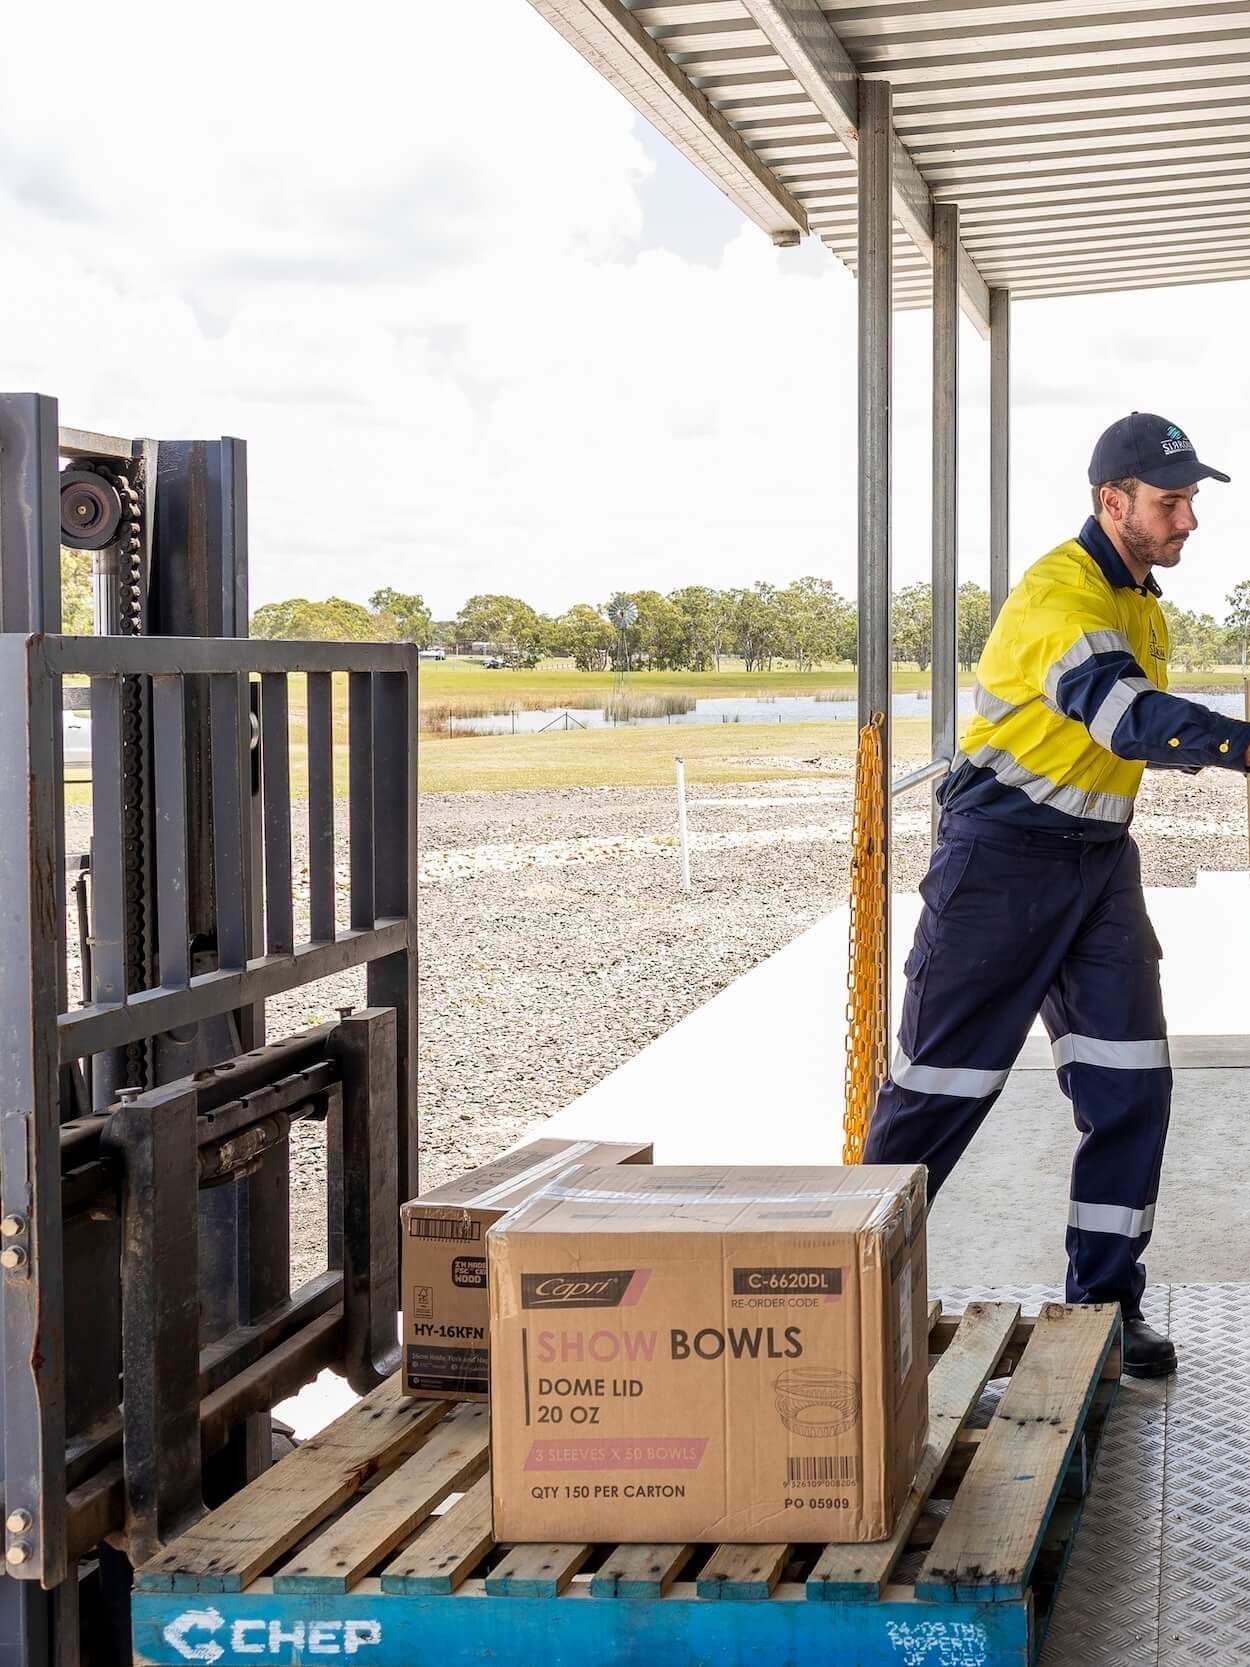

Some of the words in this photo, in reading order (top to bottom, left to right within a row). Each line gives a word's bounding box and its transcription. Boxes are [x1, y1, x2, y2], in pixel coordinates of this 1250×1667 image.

[748, 1273, 829, 1289] C-6620DL
[731, 1299, 785, 1309] RE-ORDER
[788, 1298, 820, 1308] CODE
[414, 1323, 484, 1339] HY-16KFN
[537, 1330, 658, 1362] SHOW
[670, 1326, 803, 1360] BOWLS
[538, 1378, 605, 1396] DOME
[612, 1379, 643, 1397] LID
[537, 1405, 562, 1423] 20
[570, 1406, 600, 1424] OZ
[535, 1449, 544, 1462] 3
[548, 1448, 605, 1461] SLEEVES
[609, 1448, 620, 1461] X
[624, 1448, 643, 1460] 50
[647, 1447, 697, 1461] BOWLS
[531, 1486, 559, 1499] QTY
[565, 1486, 590, 1498] 150
[594, 1486, 619, 1497] PER
[623, 1485, 685, 1497] CARTON
[784, 1498, 804, 1509] PO
[809, 1498, 849, 1509] 05909
[230, 1619, 382, 1654] CHEP
[891, 1636, 986, 1652] PROPERTY
